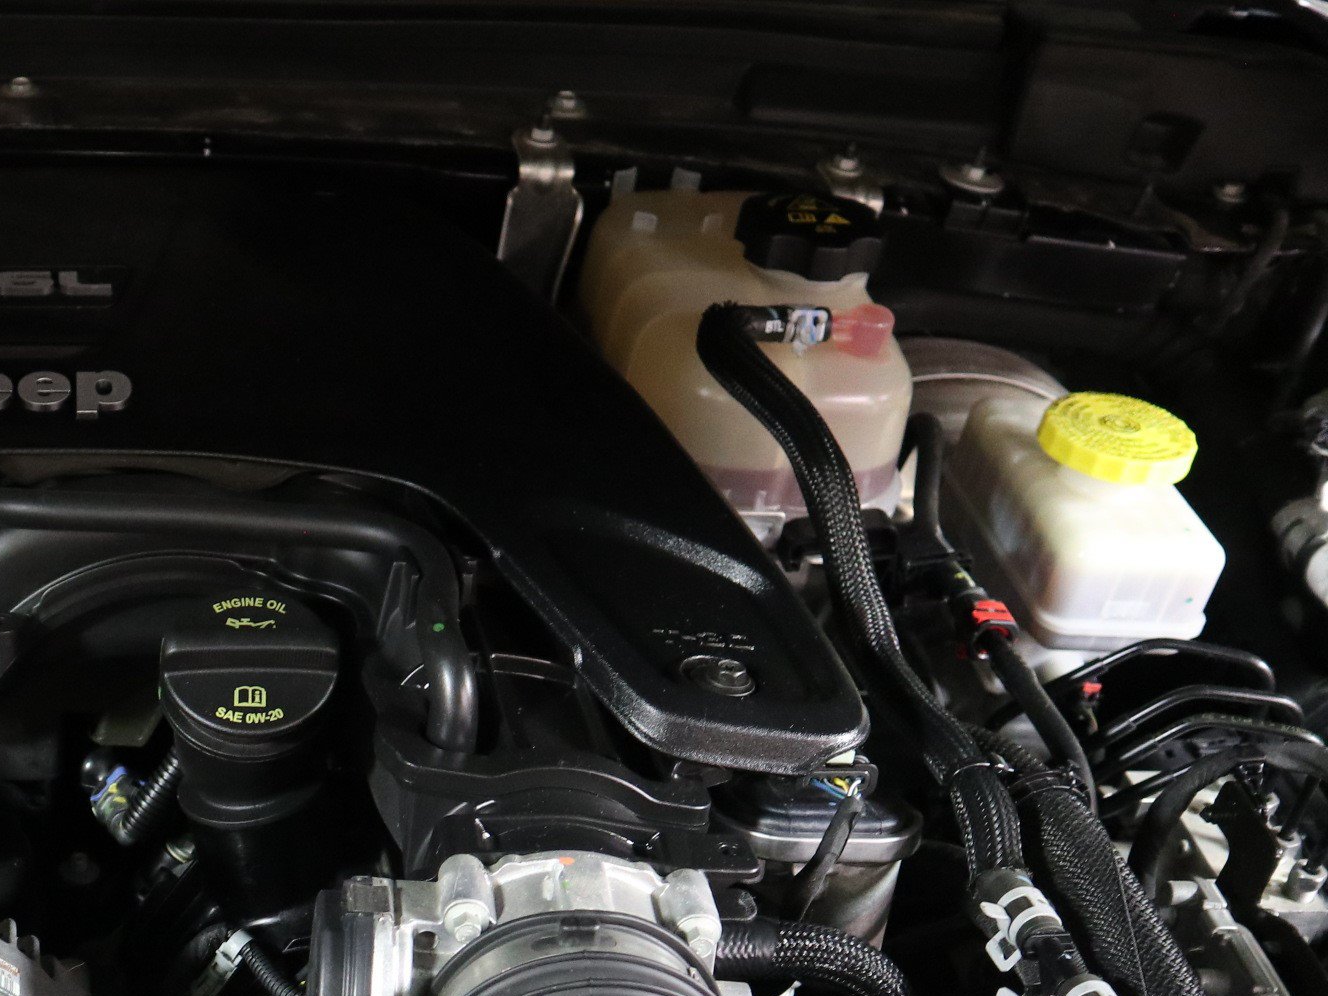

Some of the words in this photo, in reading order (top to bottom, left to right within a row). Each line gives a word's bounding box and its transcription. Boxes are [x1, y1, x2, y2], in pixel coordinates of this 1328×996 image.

[212, 596, 264, 614] ENGINE
[266, 599, 288, 615] OIL
[214, 706, 244, 724] SAE
[245, 707, 285, 724] 0W-20
